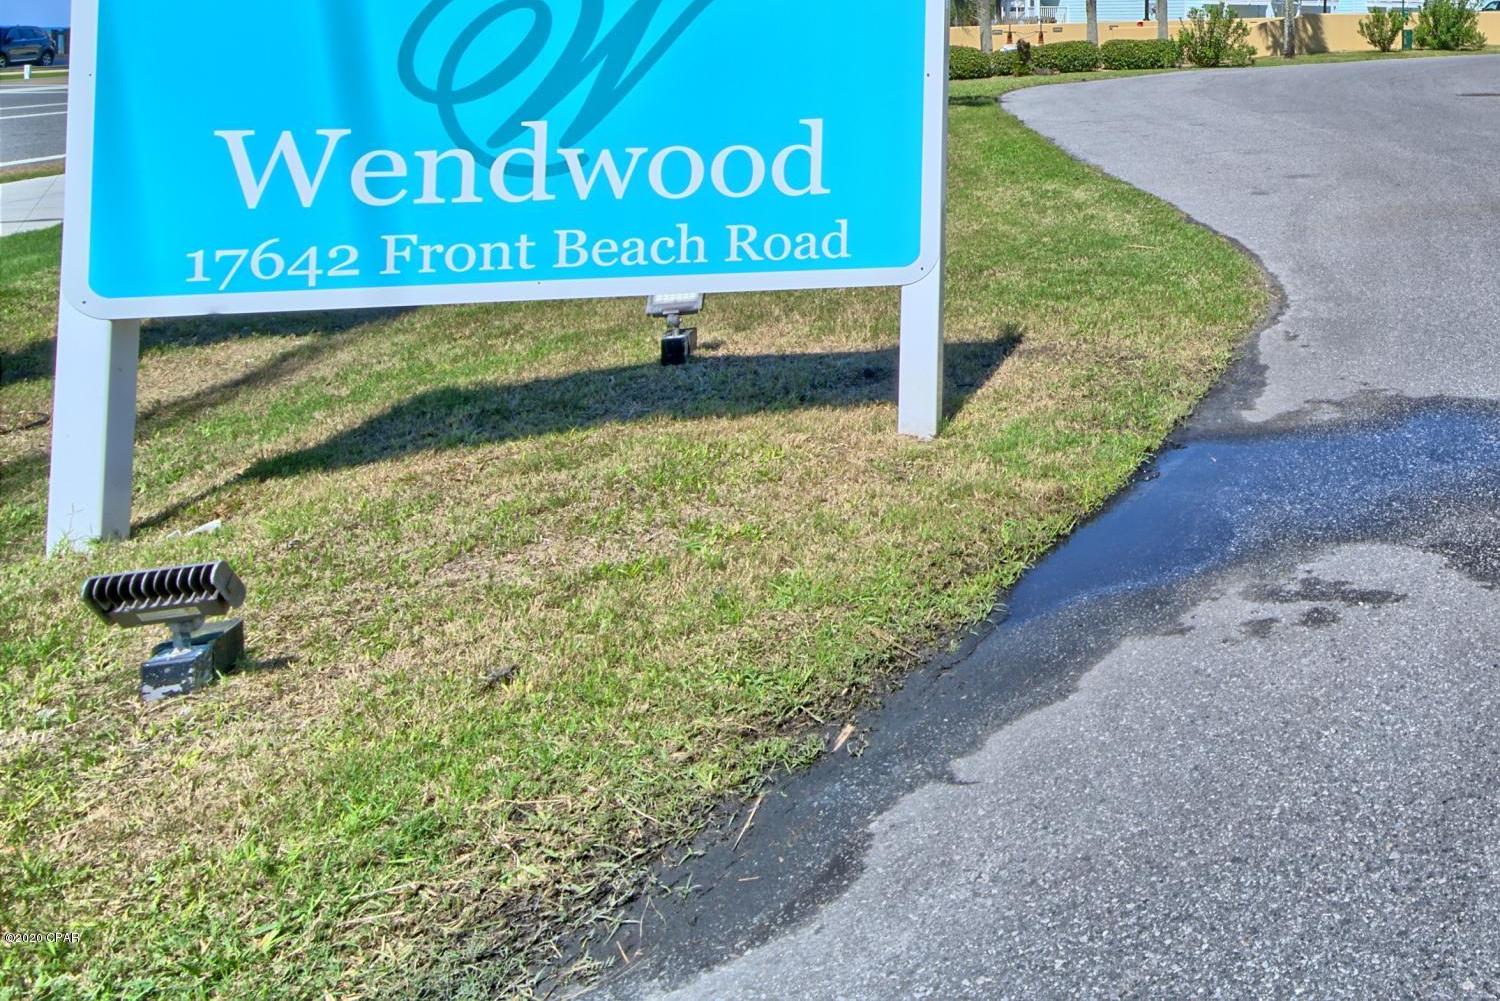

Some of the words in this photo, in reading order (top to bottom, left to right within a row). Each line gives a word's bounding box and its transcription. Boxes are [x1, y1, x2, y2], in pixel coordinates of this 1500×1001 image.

[213, 118, 831, 209] Wendwood
[185, 239, 361, 291] 17642
[380, 232, 537, 274] Front
[553, 223, 709, 268] Beach
[725, 219, 852, 262] Road
